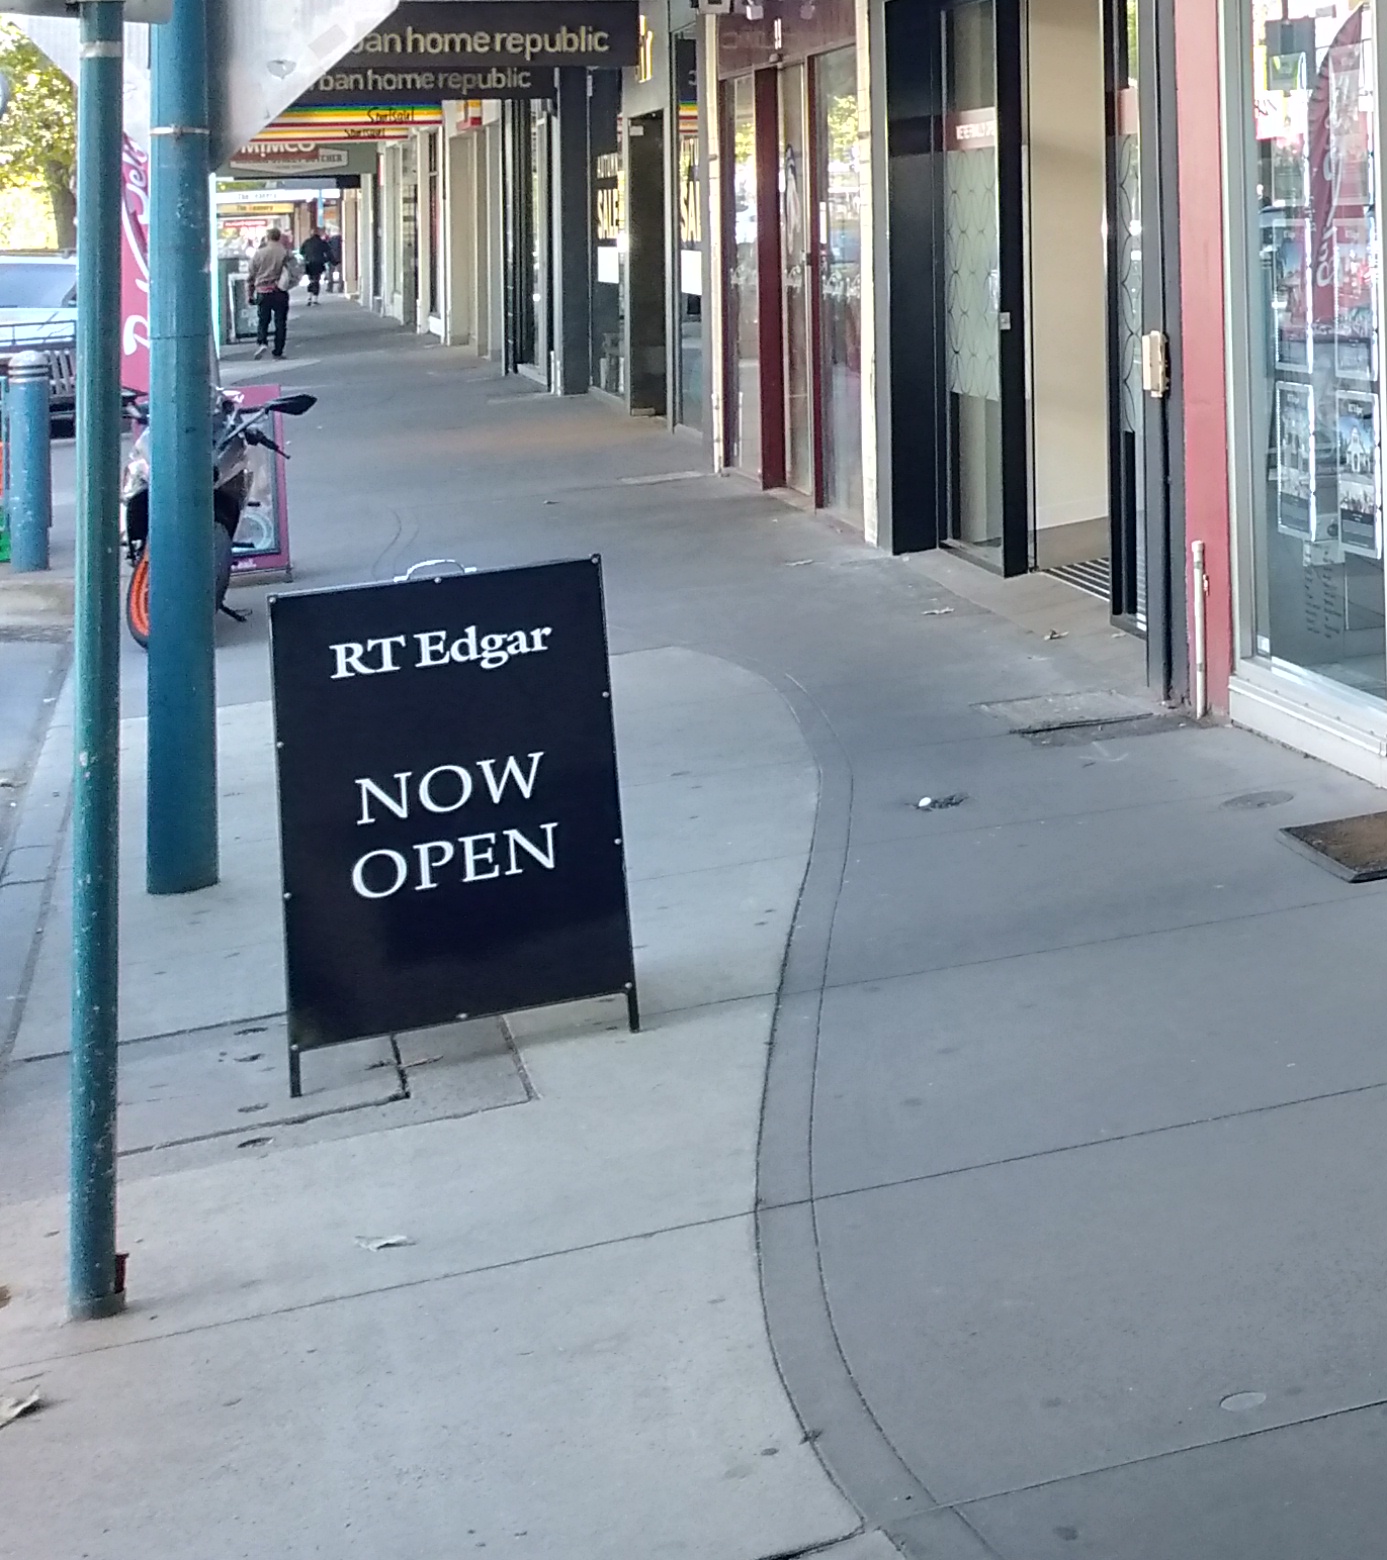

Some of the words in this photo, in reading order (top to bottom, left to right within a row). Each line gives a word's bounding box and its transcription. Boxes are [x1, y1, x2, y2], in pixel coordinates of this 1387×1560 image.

[406, 25, 490, 54] home
[494, 25, 610, 61] republic
[366, 68, 435, 91] home
[438, 67, 532, 95] republic
[328, 634, 407, 679] RT
[413, 624, 553, 669] Edgar
[354, 751, 546, 826] NOW
[352, 821, 559, 900] OPEN
